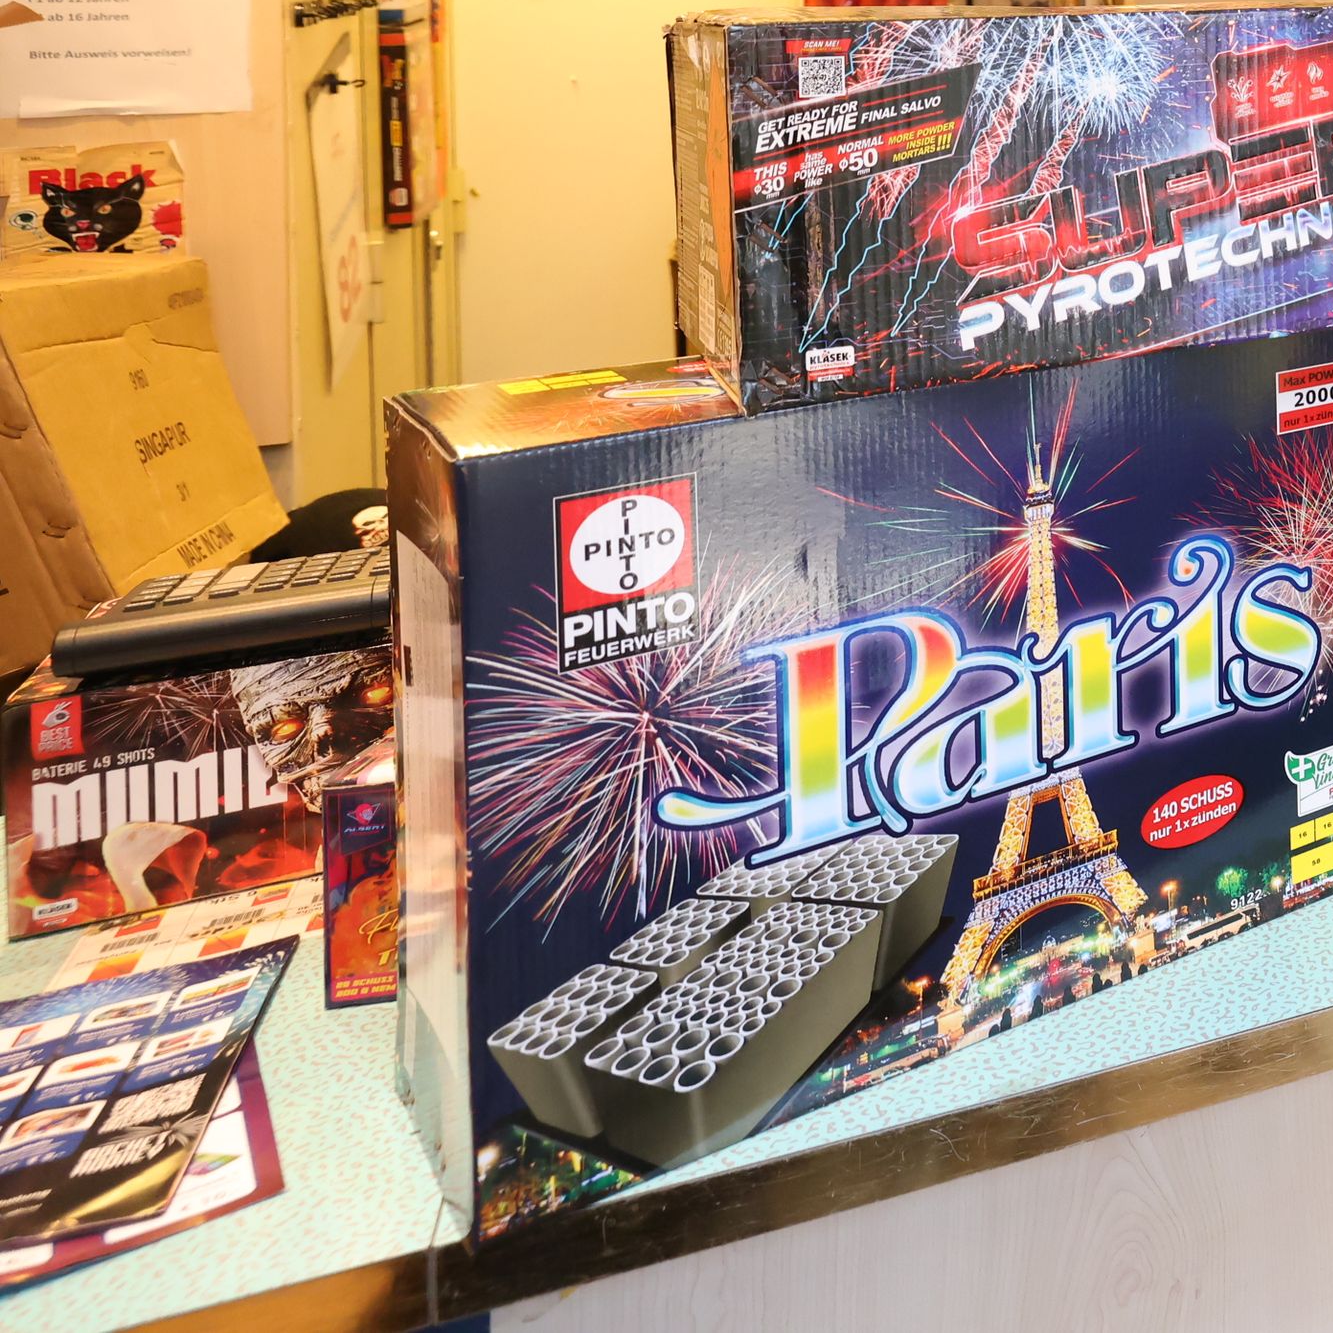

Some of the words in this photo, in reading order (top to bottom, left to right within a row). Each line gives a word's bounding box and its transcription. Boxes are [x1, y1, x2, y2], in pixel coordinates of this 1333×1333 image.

[755, 111, 858, 153] EXTREME
[860, 106, 898, 125] FINAL
[900, 95, 942, 116] SALVO
[787, 108, 829, 125] READY
[831, 100, 859, 117] FOR
[28, 164, 161, 195] Black
[134, 421, 191, 466] SINGAPUR
[177, 537, 203, 569] MADE
[563, 591, 695, 648] PINTO
[564, 623, 695, 667] FEUERWERK
[655, 534, 1323, 869] Paris
[32, 760, 86, 781] BATERIE
[93, 756, 111, 769] 49
[117, 747, 155, 765] SHOTS
[1152, 803, 1179, 823] 140
[1180, 781, 1234, 814] SCHUSS
